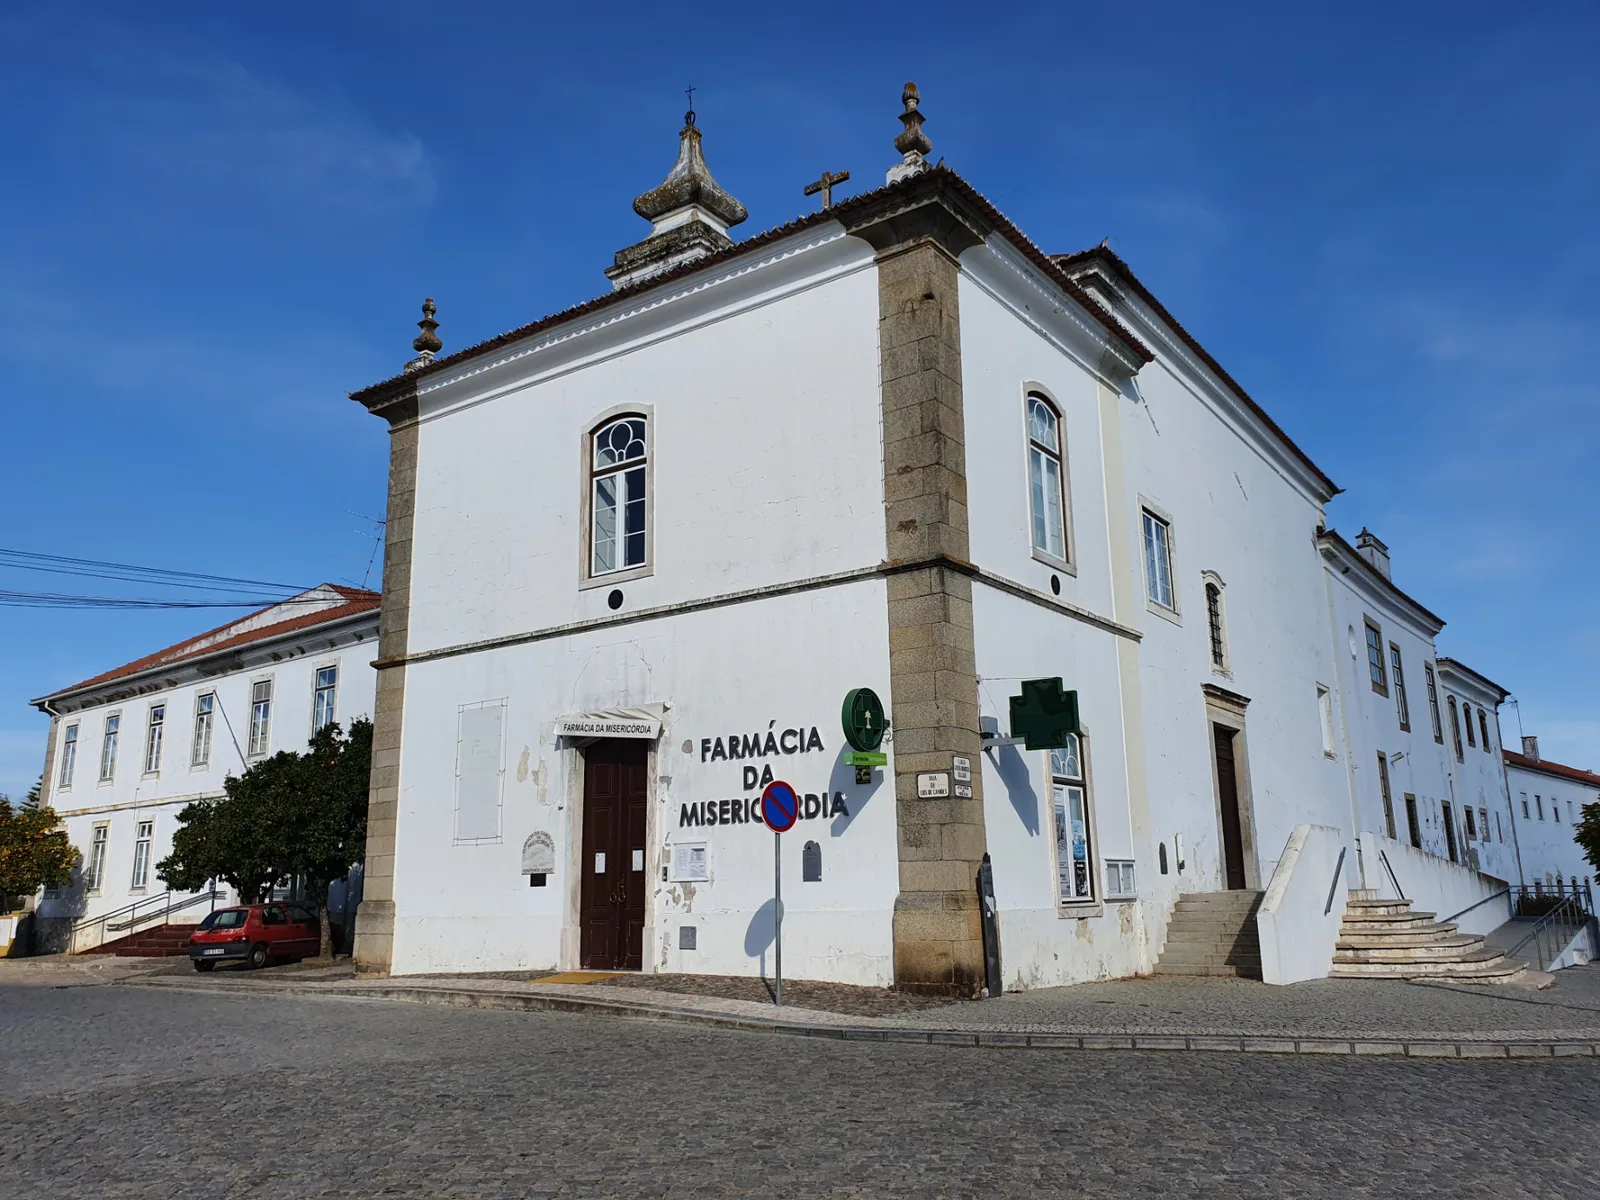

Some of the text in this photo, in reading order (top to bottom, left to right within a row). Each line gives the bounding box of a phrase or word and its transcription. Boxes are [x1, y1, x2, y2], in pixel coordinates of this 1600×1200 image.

[563, 722, 651, 734] FARMÁCIA DA MISERICÓRDIA
[701, 720, 825, 763] FARMÁCIA
[743, 764, 774, 791] DA
[679, 791, 849, 827] MISERICDIA
